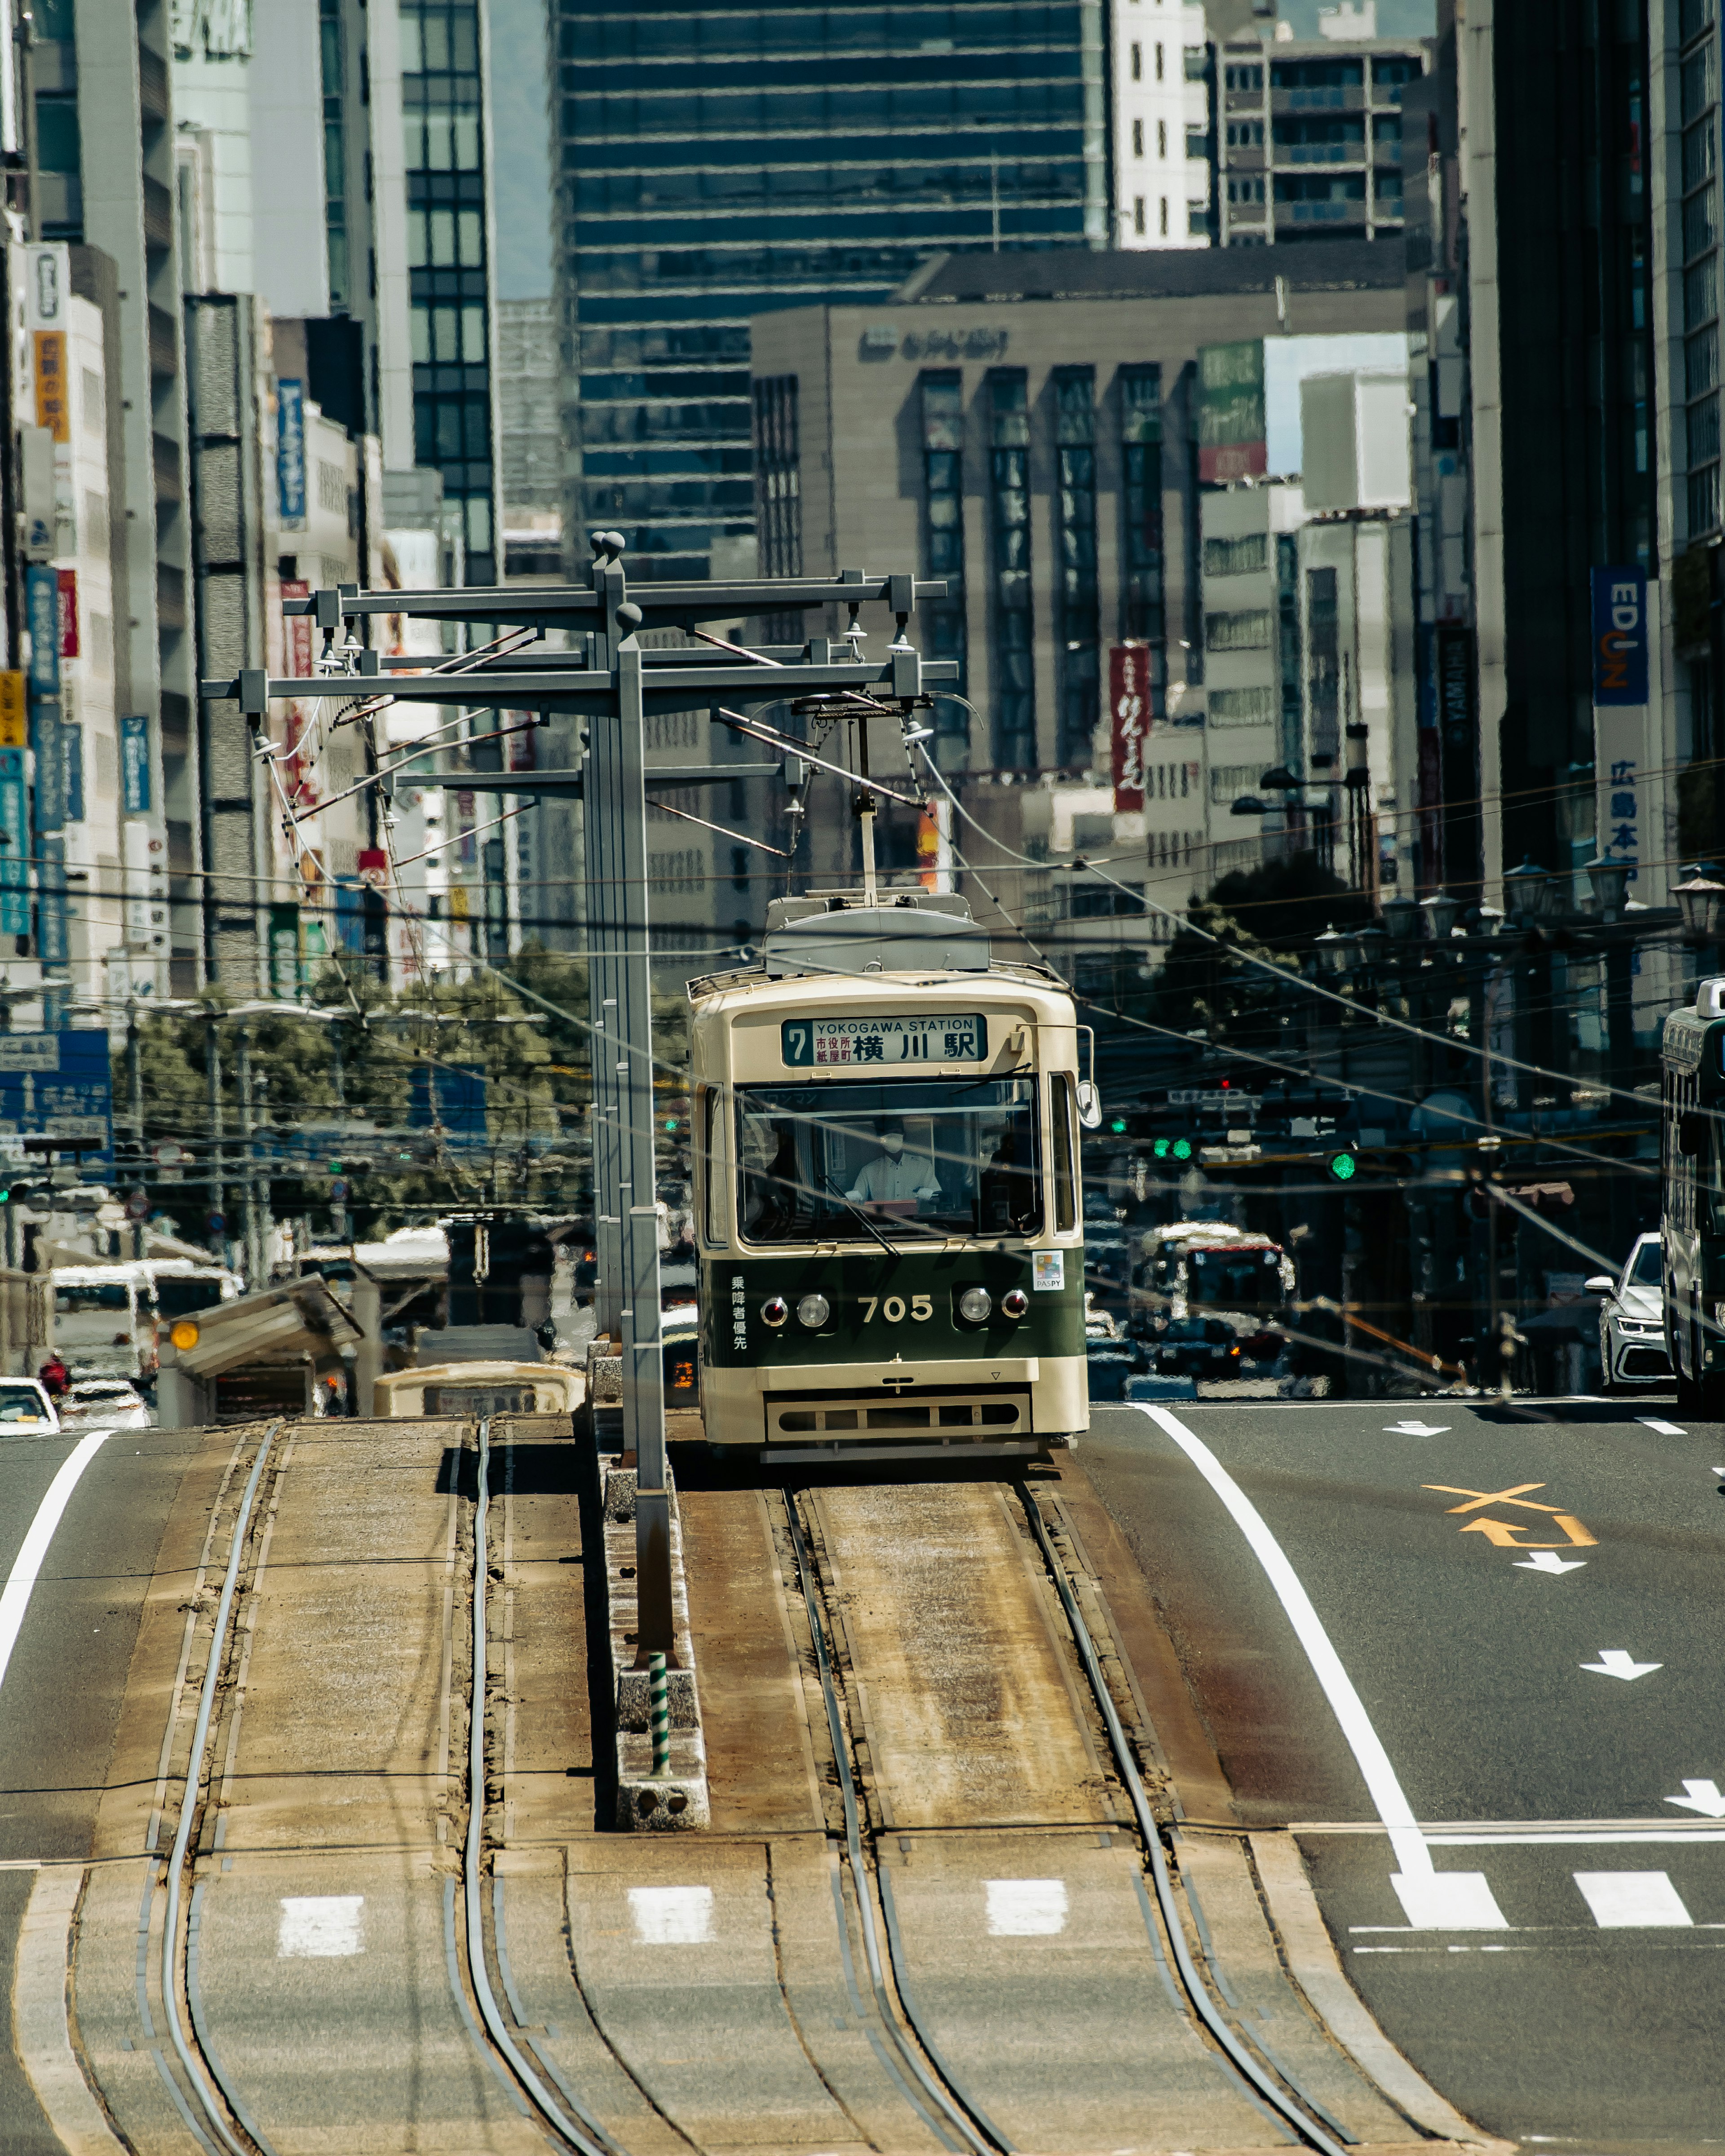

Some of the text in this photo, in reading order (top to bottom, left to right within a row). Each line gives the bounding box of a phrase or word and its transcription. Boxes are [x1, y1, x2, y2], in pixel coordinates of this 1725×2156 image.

[1600, 583, 1638, 688] EDION
[1445, 641, 1467, 722] YAMAHA
[817, 1019, 973, 1034] YOKOGAWA STATION
[789, 1029, 805, 1060] 7
[816, 1037, 850, 1050] 市役所
[817, 1050, 851, 1063] 紙屋町
[853, 1033, 975, 1061] 横川駅
[767, 1093, 817, 1105] ワンマン
[731, 1276, 747, 1350] 乗降者優先
[858, 1294, 933, 1323] 705
